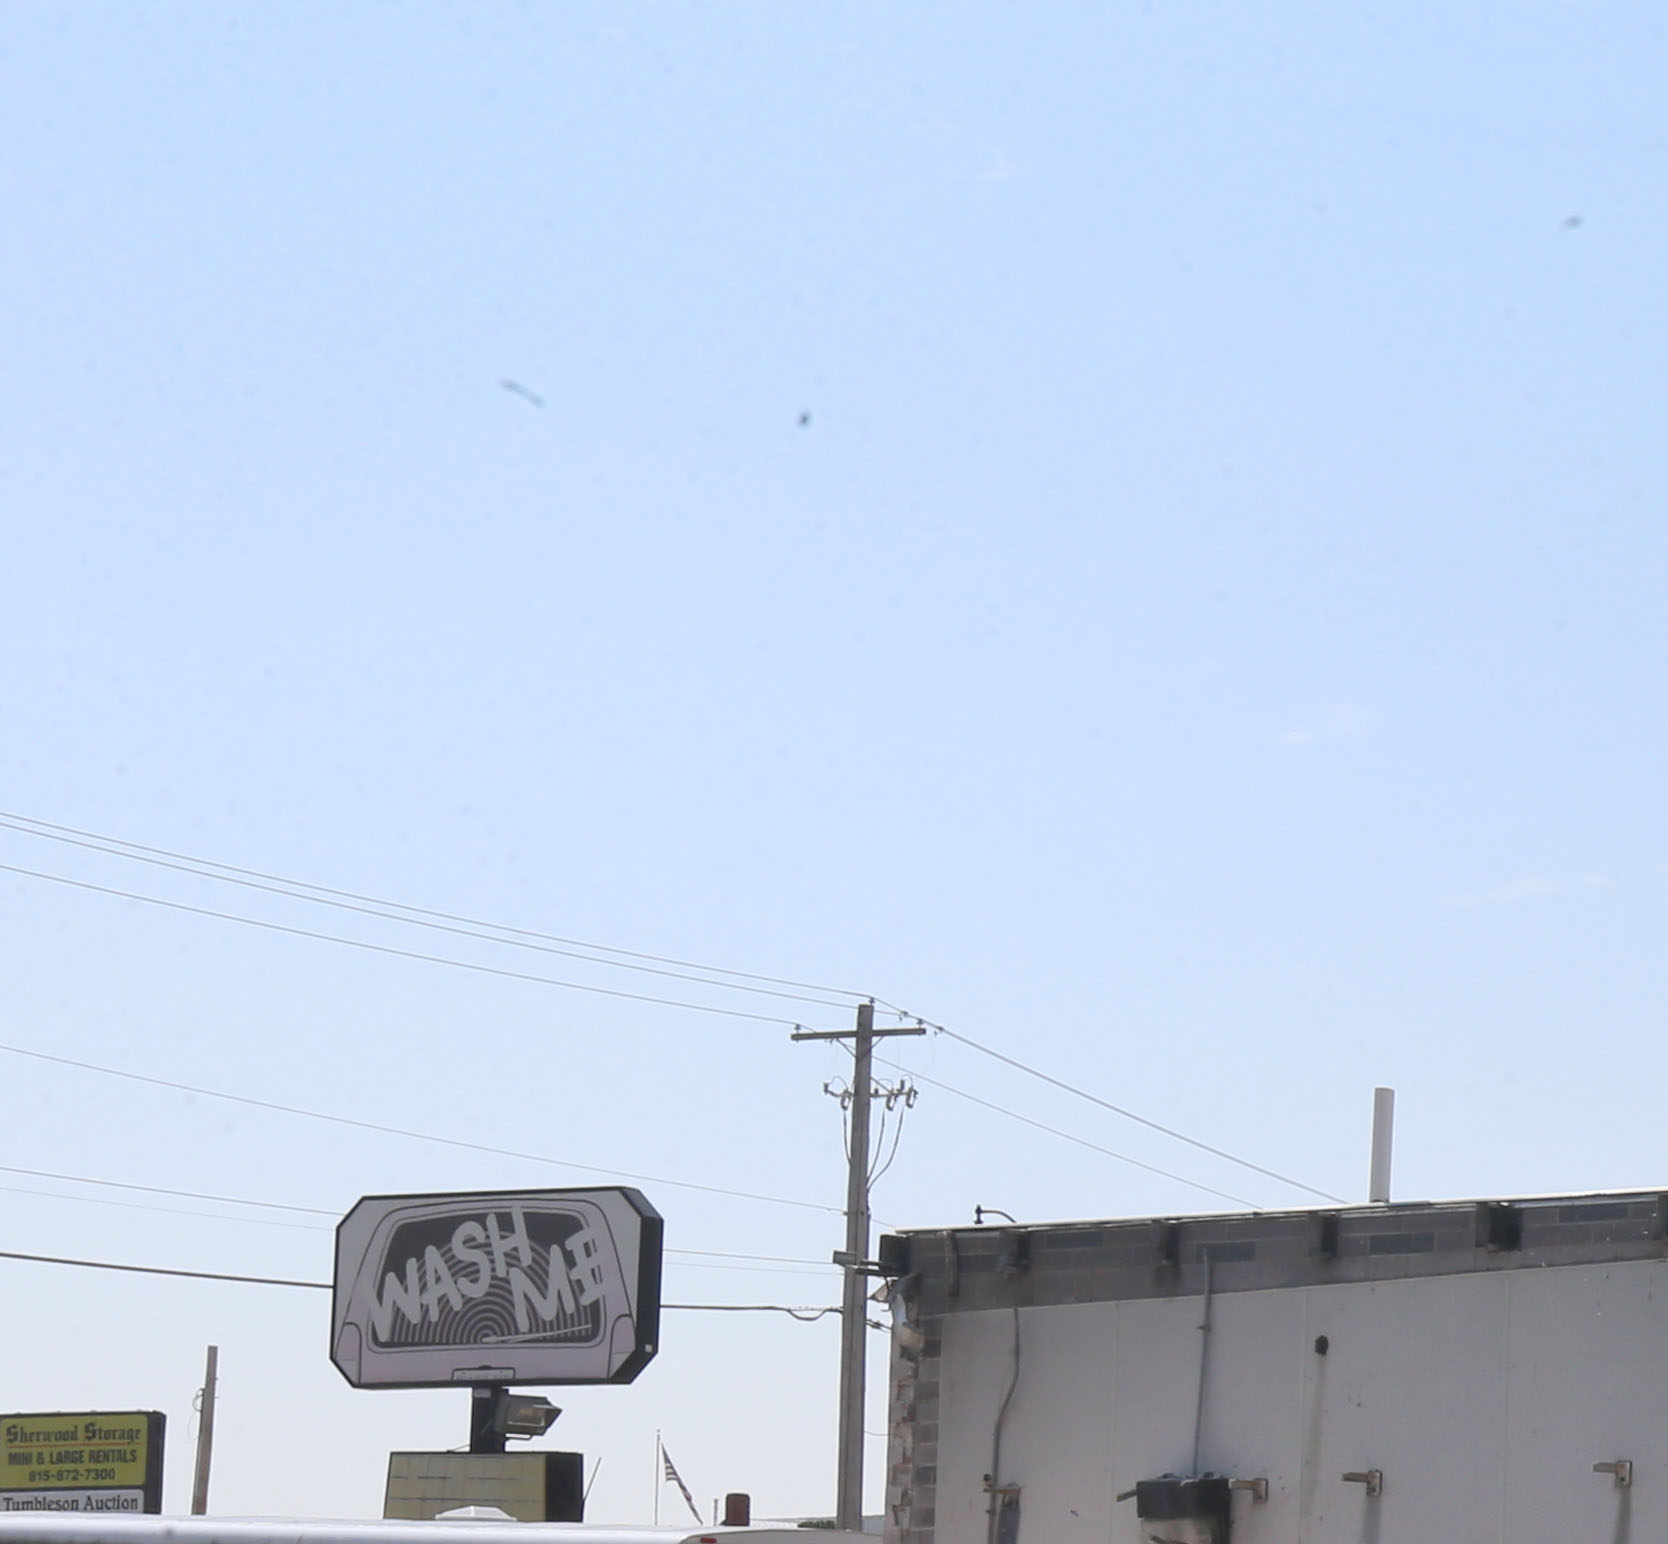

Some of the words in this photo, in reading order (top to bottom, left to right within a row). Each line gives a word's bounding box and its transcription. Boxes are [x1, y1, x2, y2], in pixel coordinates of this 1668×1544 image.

[366, 1206, 531, 1342] WASH
[509, 1226, 605, 1332] ME
[6, 1424, 78, 1443] Sherwood
[84, 1422, 142, 1445] Storage
[8, 1452, 33, 1465] MINI
[50, 1450, 85, 1464] LARGE
[89, 1449, 137, 1463] RENTALS
[29, 1468, 116, 1482] 815-872-7300
[3, 1496, 79, 1511] Tumbleson
[84, 1495, 138, 1511] Auction
